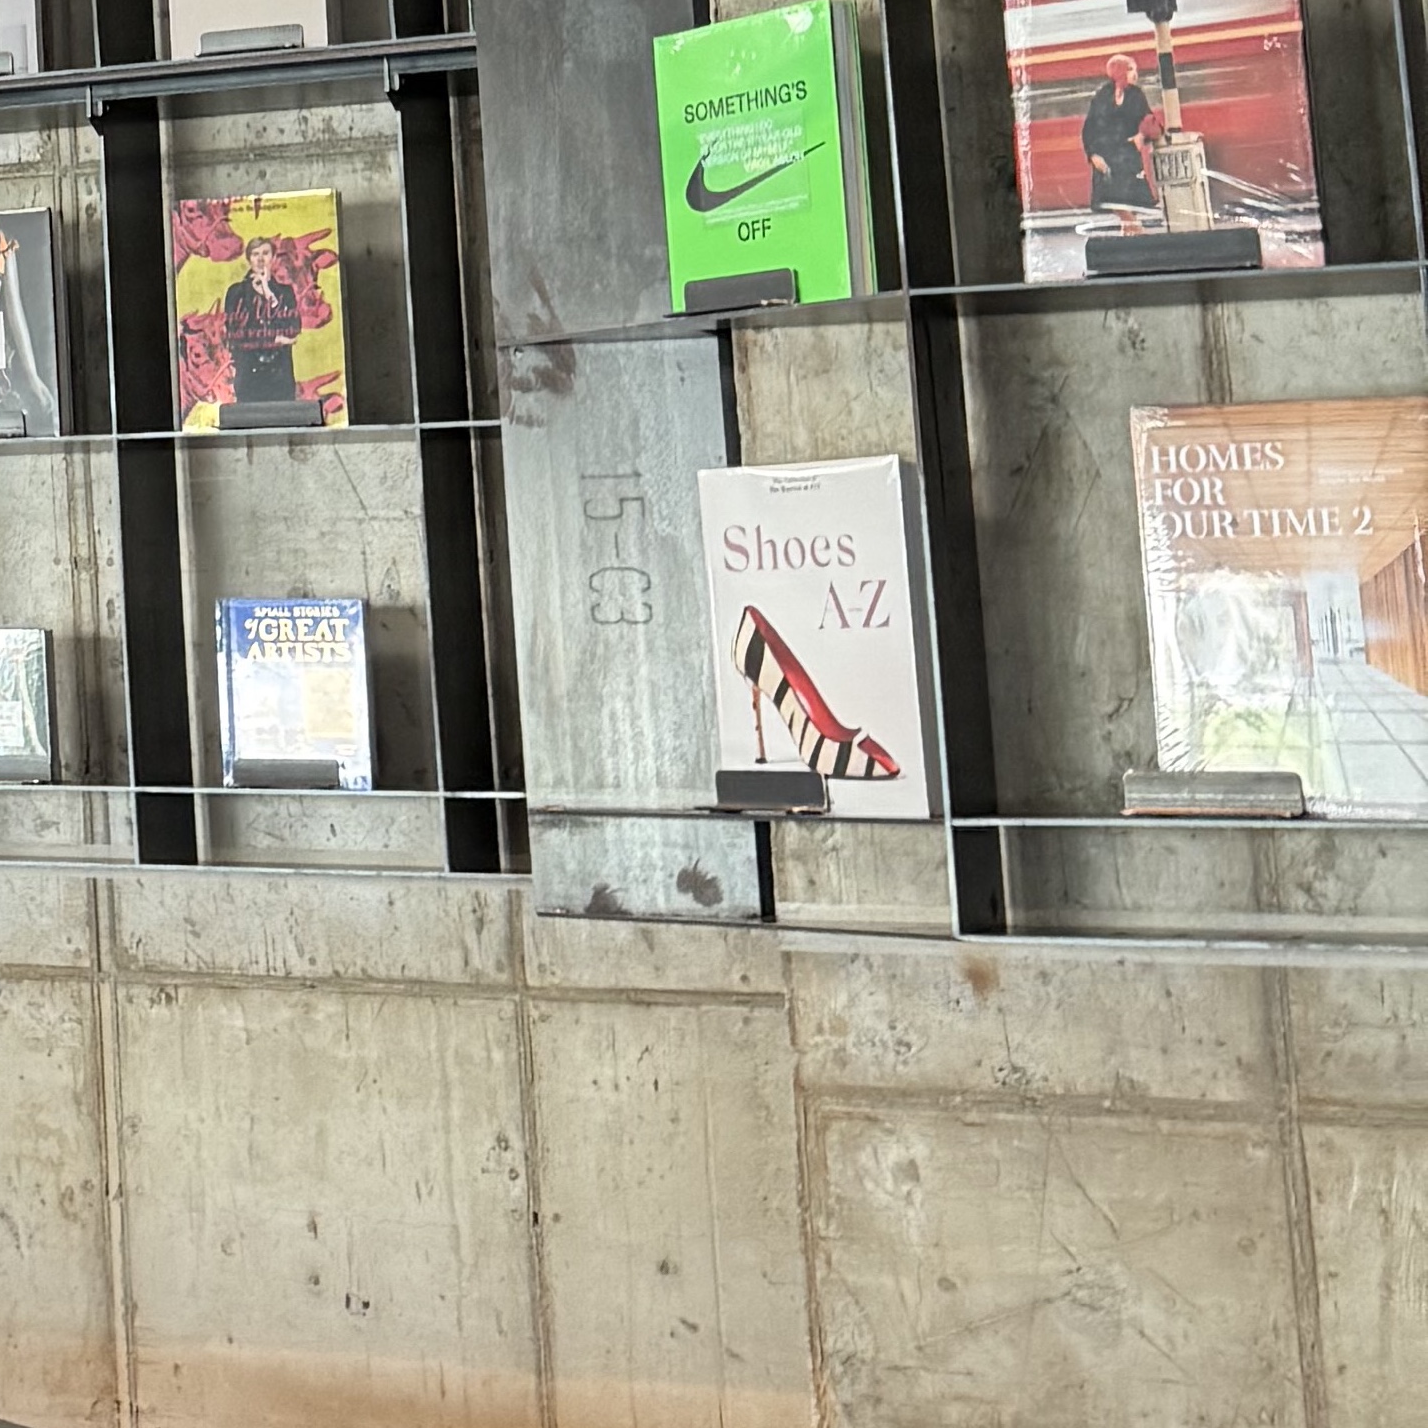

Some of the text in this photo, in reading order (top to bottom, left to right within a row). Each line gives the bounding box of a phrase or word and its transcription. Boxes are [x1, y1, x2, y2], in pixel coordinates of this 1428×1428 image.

[684, 80, 807, 124] SOMETHING'S
[737, 218, 772, 242] OFF
[1150, 441, 1284, 473] HOMES
[1154, 476, 1225, 507] FOR
[1154, 505, 1374, 540] OUR TIME 2
[722, 524, 857, 573] Shoes
[255, 606, 340, 618] SMALL STORIES
[818, 579, 891, 630] A-Z
[258, 618, 349, 643] GREAT
[246, 641, 352, 664] ARTISTS
